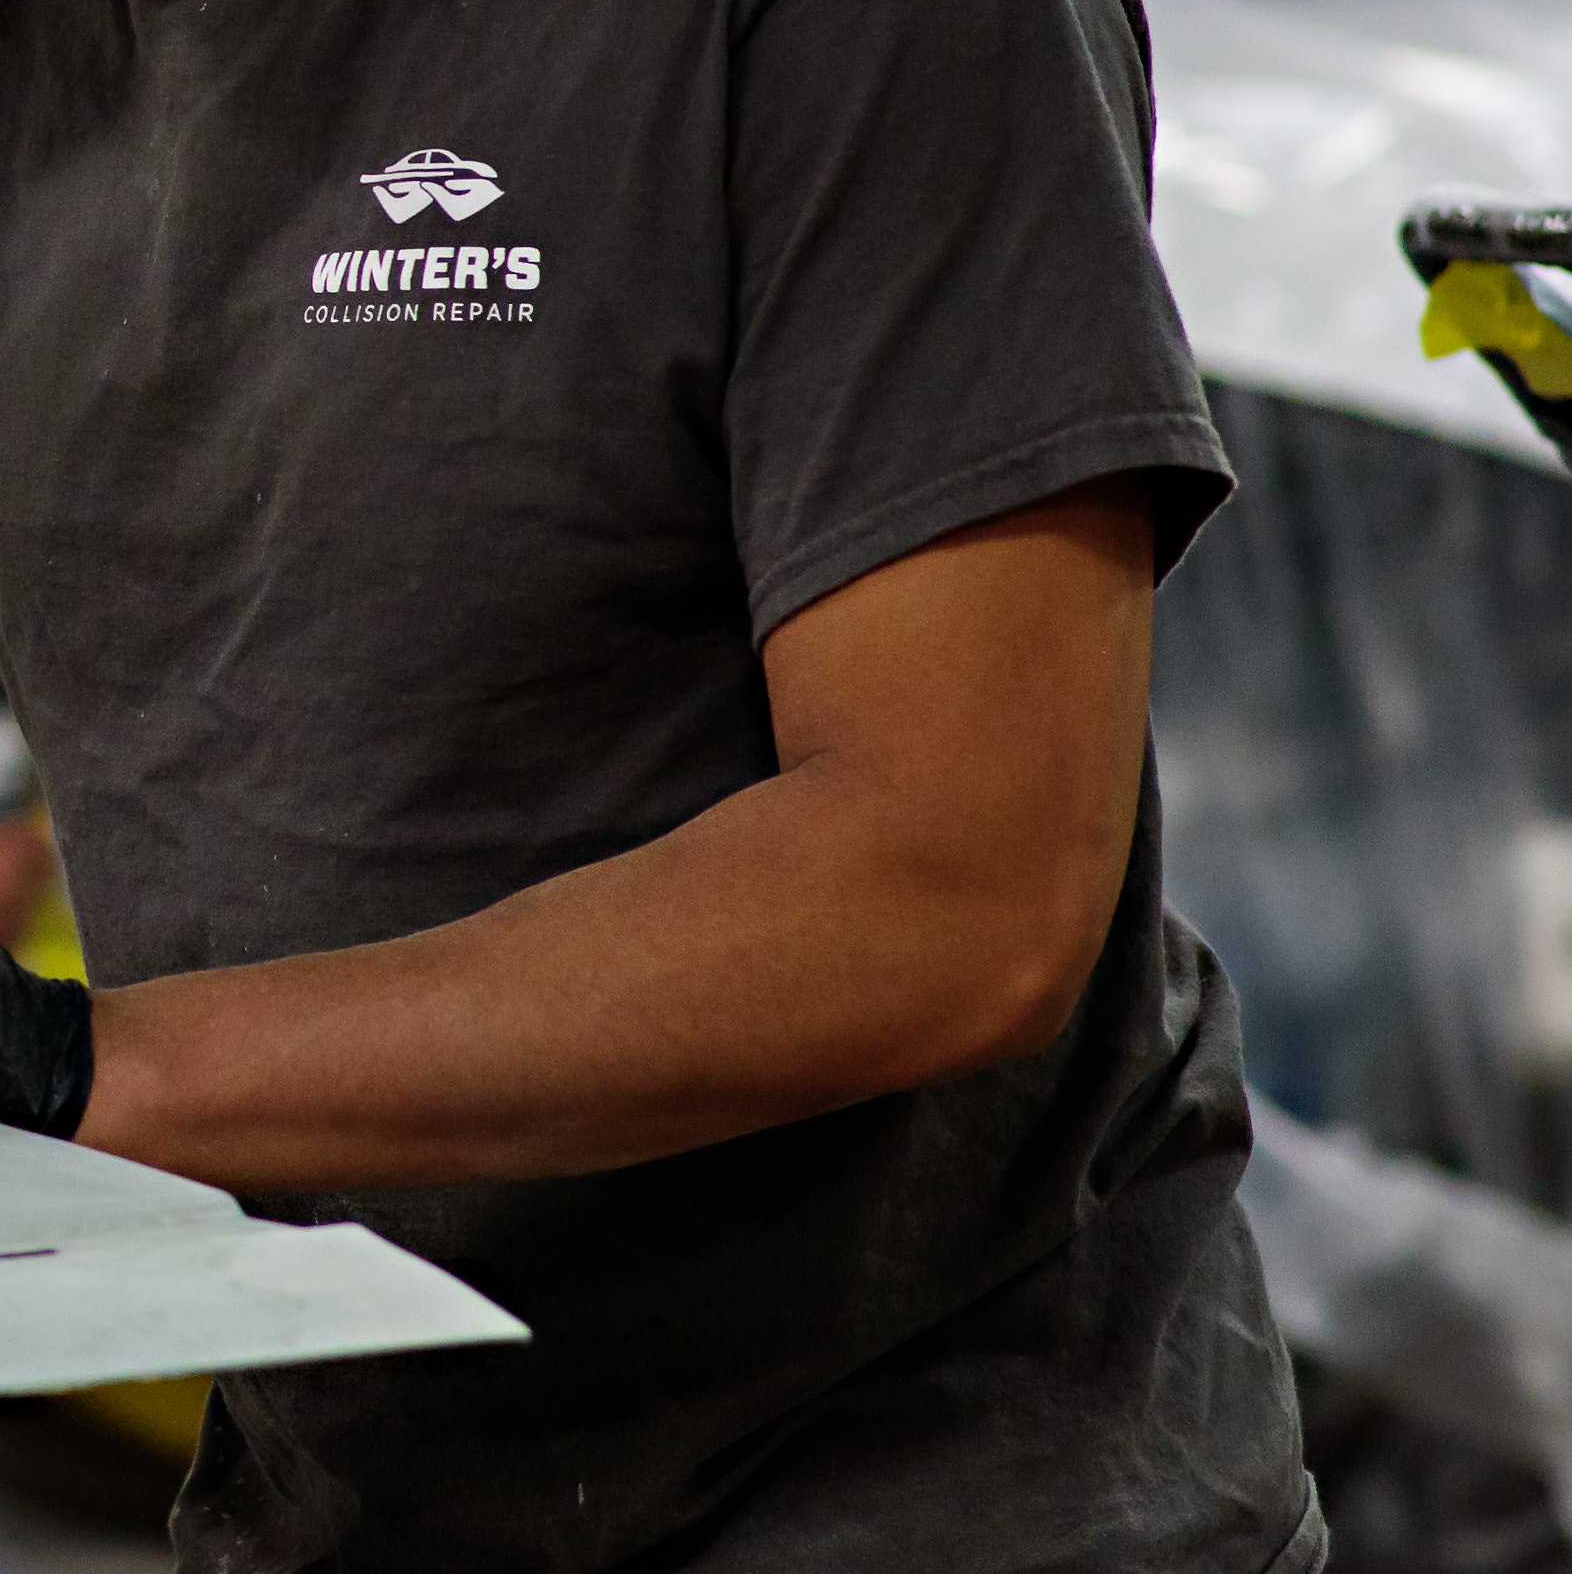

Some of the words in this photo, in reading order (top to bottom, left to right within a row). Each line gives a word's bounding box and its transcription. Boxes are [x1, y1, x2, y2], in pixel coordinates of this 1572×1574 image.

[310, 246, 542, 294] WINTER'S
[303, 302, 419, 324] COLLISION
[432, 302, 535, 322] REPAIR
